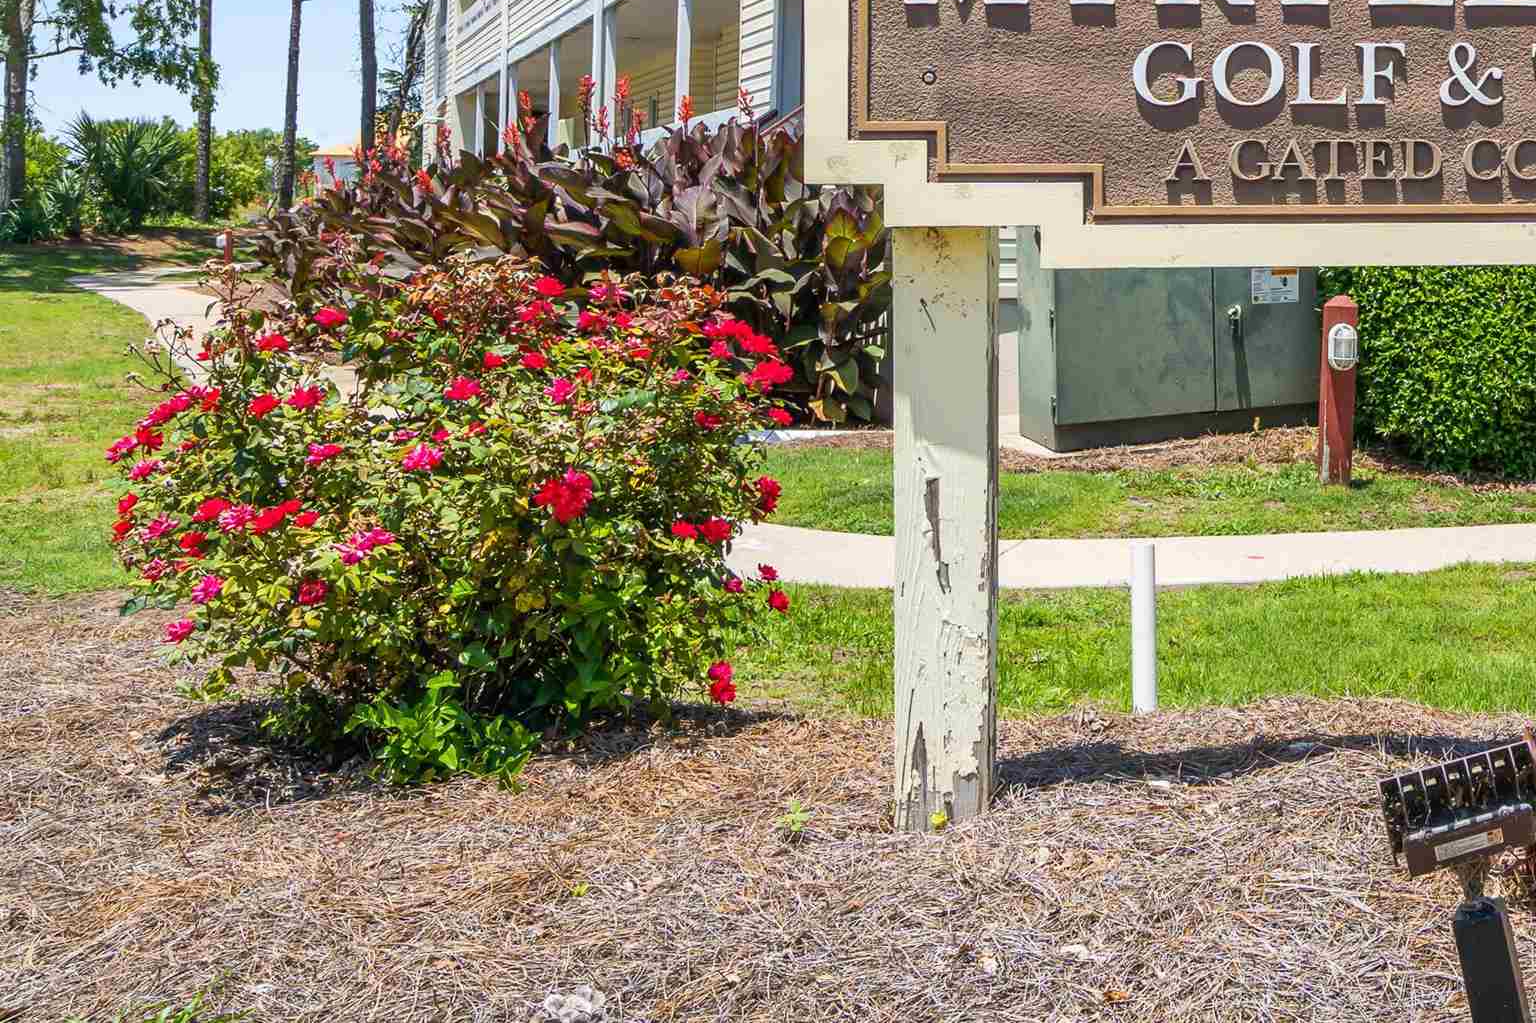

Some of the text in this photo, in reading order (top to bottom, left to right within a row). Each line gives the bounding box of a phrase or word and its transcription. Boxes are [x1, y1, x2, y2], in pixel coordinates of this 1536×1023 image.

[1133, 41, 1406, 107] GOLF
[1439, 41, 1504, 107] &
[1168, 138, 1211, 181] A
[1230, 138, 1444, 181] GATED
